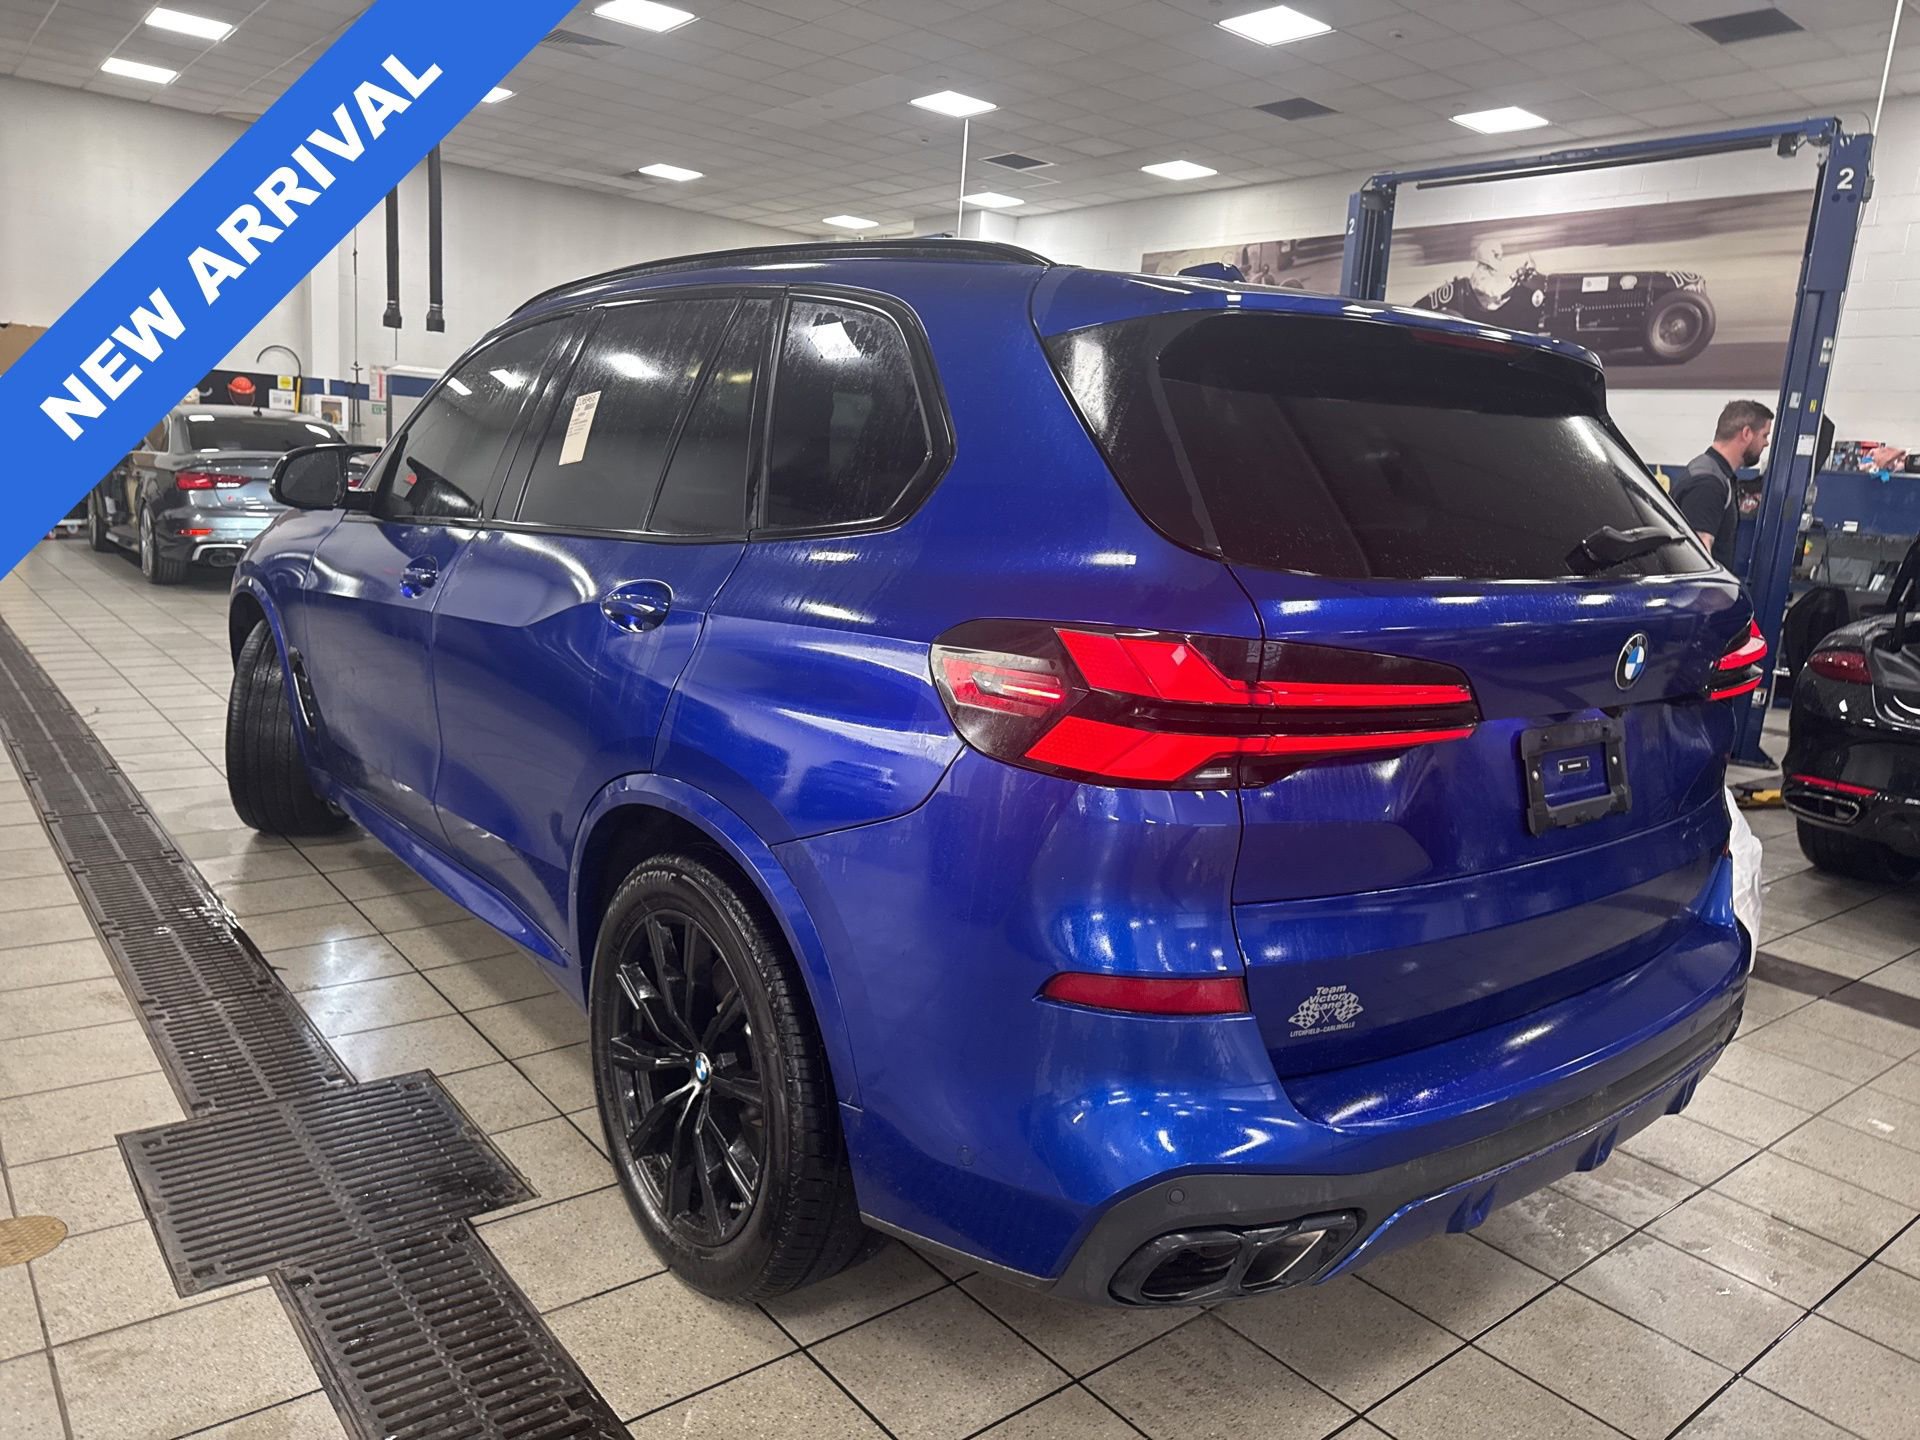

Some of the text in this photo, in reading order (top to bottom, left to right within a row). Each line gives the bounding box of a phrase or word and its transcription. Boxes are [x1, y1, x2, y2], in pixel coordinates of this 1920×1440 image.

[1837, 167, 1854, 190] 2
[1348, 217, 1355, 235] 2
[1429, 280, 1454, 310] 10
[1316, 985, 1347, 995] Team
[1308, 992, 1348, 1005] Victory
[1313, 1001, 1342, 1012] Lane
